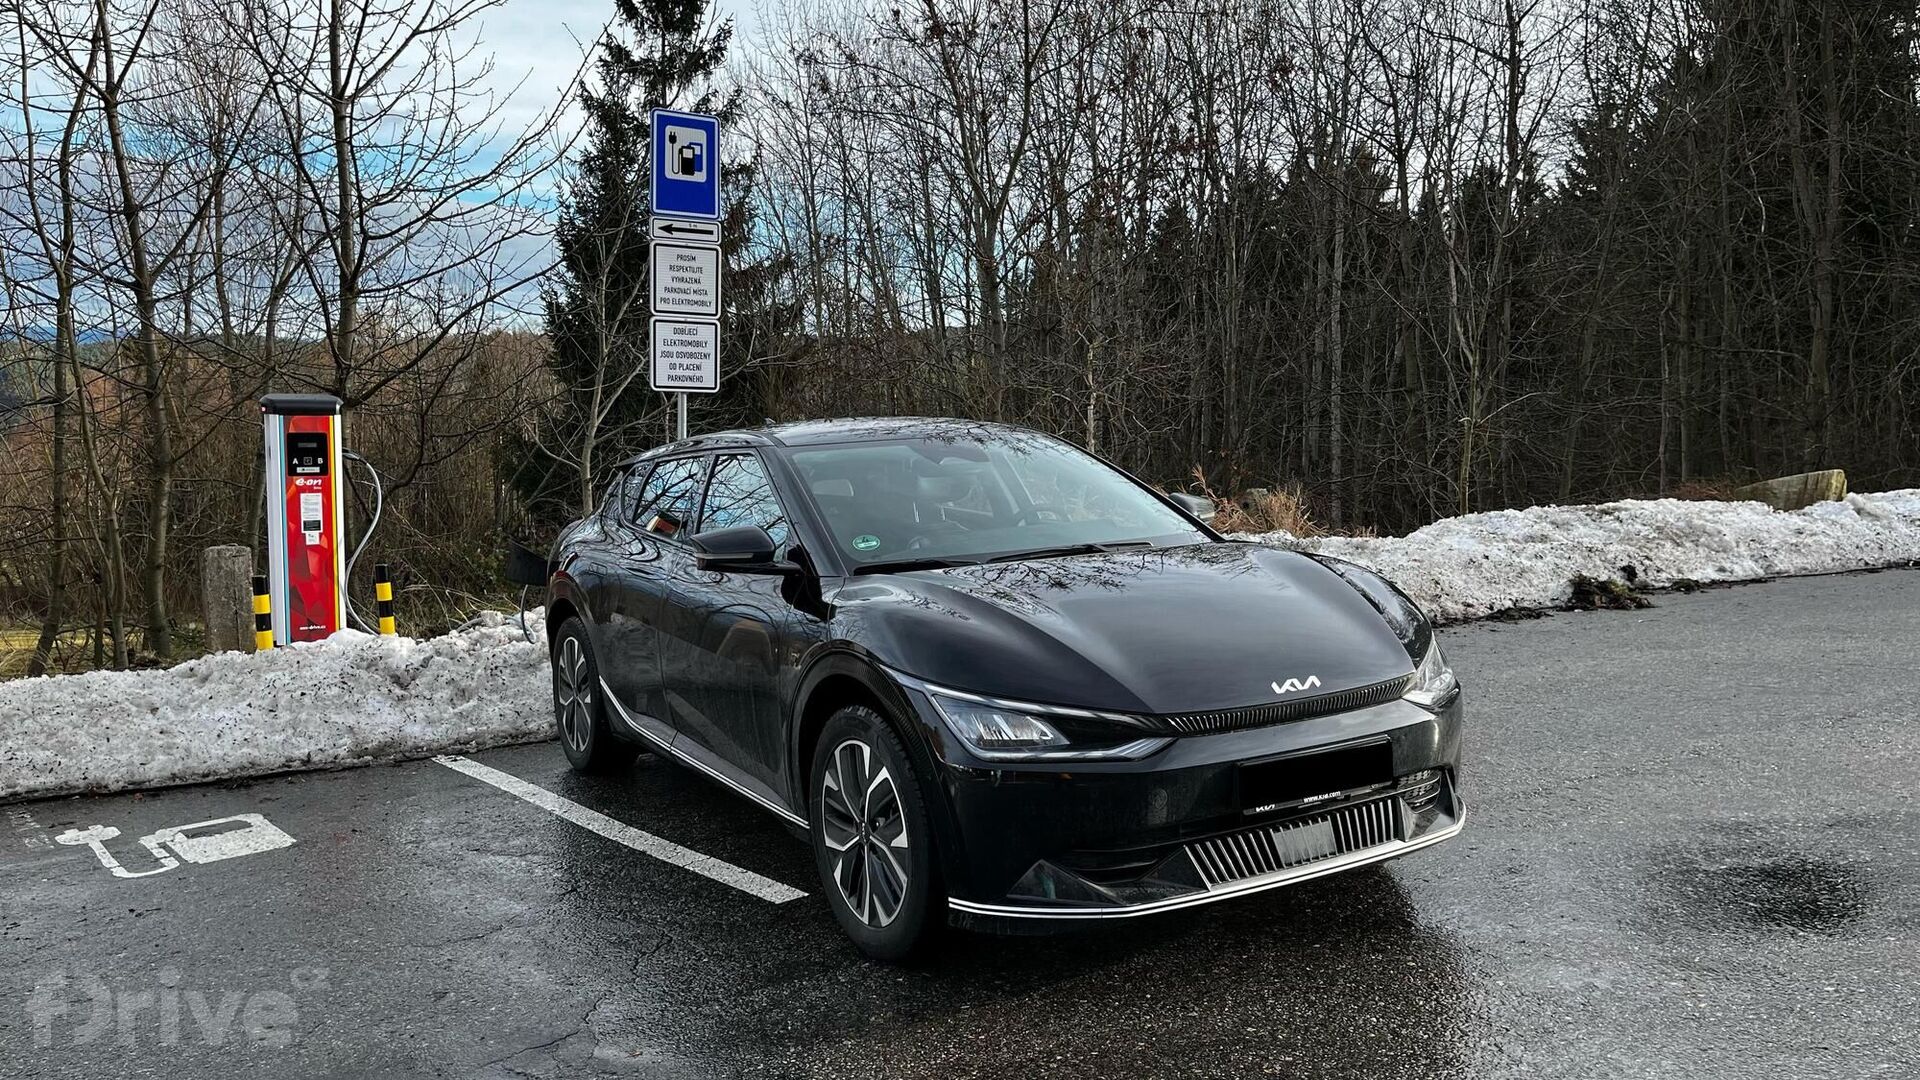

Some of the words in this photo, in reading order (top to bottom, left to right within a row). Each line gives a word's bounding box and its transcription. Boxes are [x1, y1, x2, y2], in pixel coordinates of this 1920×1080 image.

[676, 253, 696, 262] PROSÍM
[669, 264, 703, 274] RESPEKTUJTE
[671, 276, 702, 285] VYHRAZENÁ
[664, 286, 691, 295] PARKOVACÍ
[692, 287, 708, 296] MÍSTA
[660, 297, 670, 305] PRO
[672, 298, 712, 307] ELEKTROMOBILY
[673, 326, 698, 336] DOBÍJECÍ
[662, 338, 708, 348] ELEKTROMOBILY
[676, 351, 711, 360] OSVOBOZENY
[678, 362, 702, 372] PLACENÍ
[668, 373, 703, 383] PARKOVNÉHO
[1271, 675, 1322, 694] KIA
